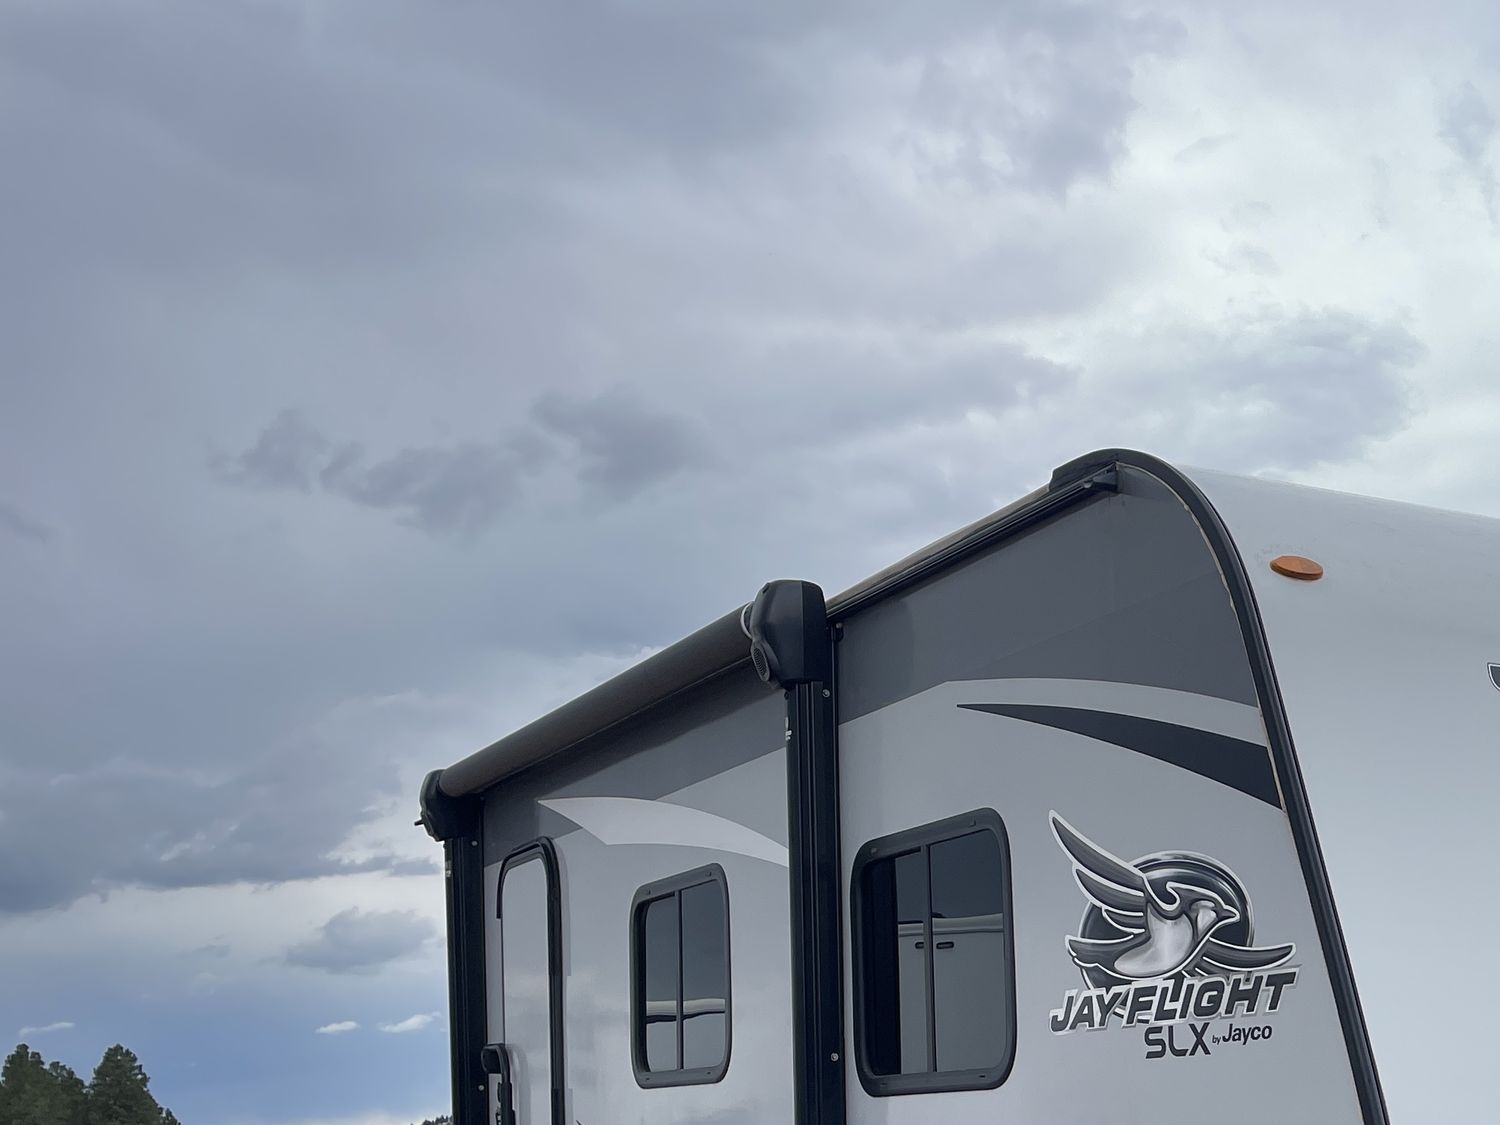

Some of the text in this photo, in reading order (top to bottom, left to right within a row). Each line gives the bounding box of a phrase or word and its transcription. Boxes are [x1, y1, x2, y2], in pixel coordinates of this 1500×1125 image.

[1050, 970, 1298, 1034] JAY FLIGHT
[1144, 1022, 1273, 1060] SLX by Jayco
